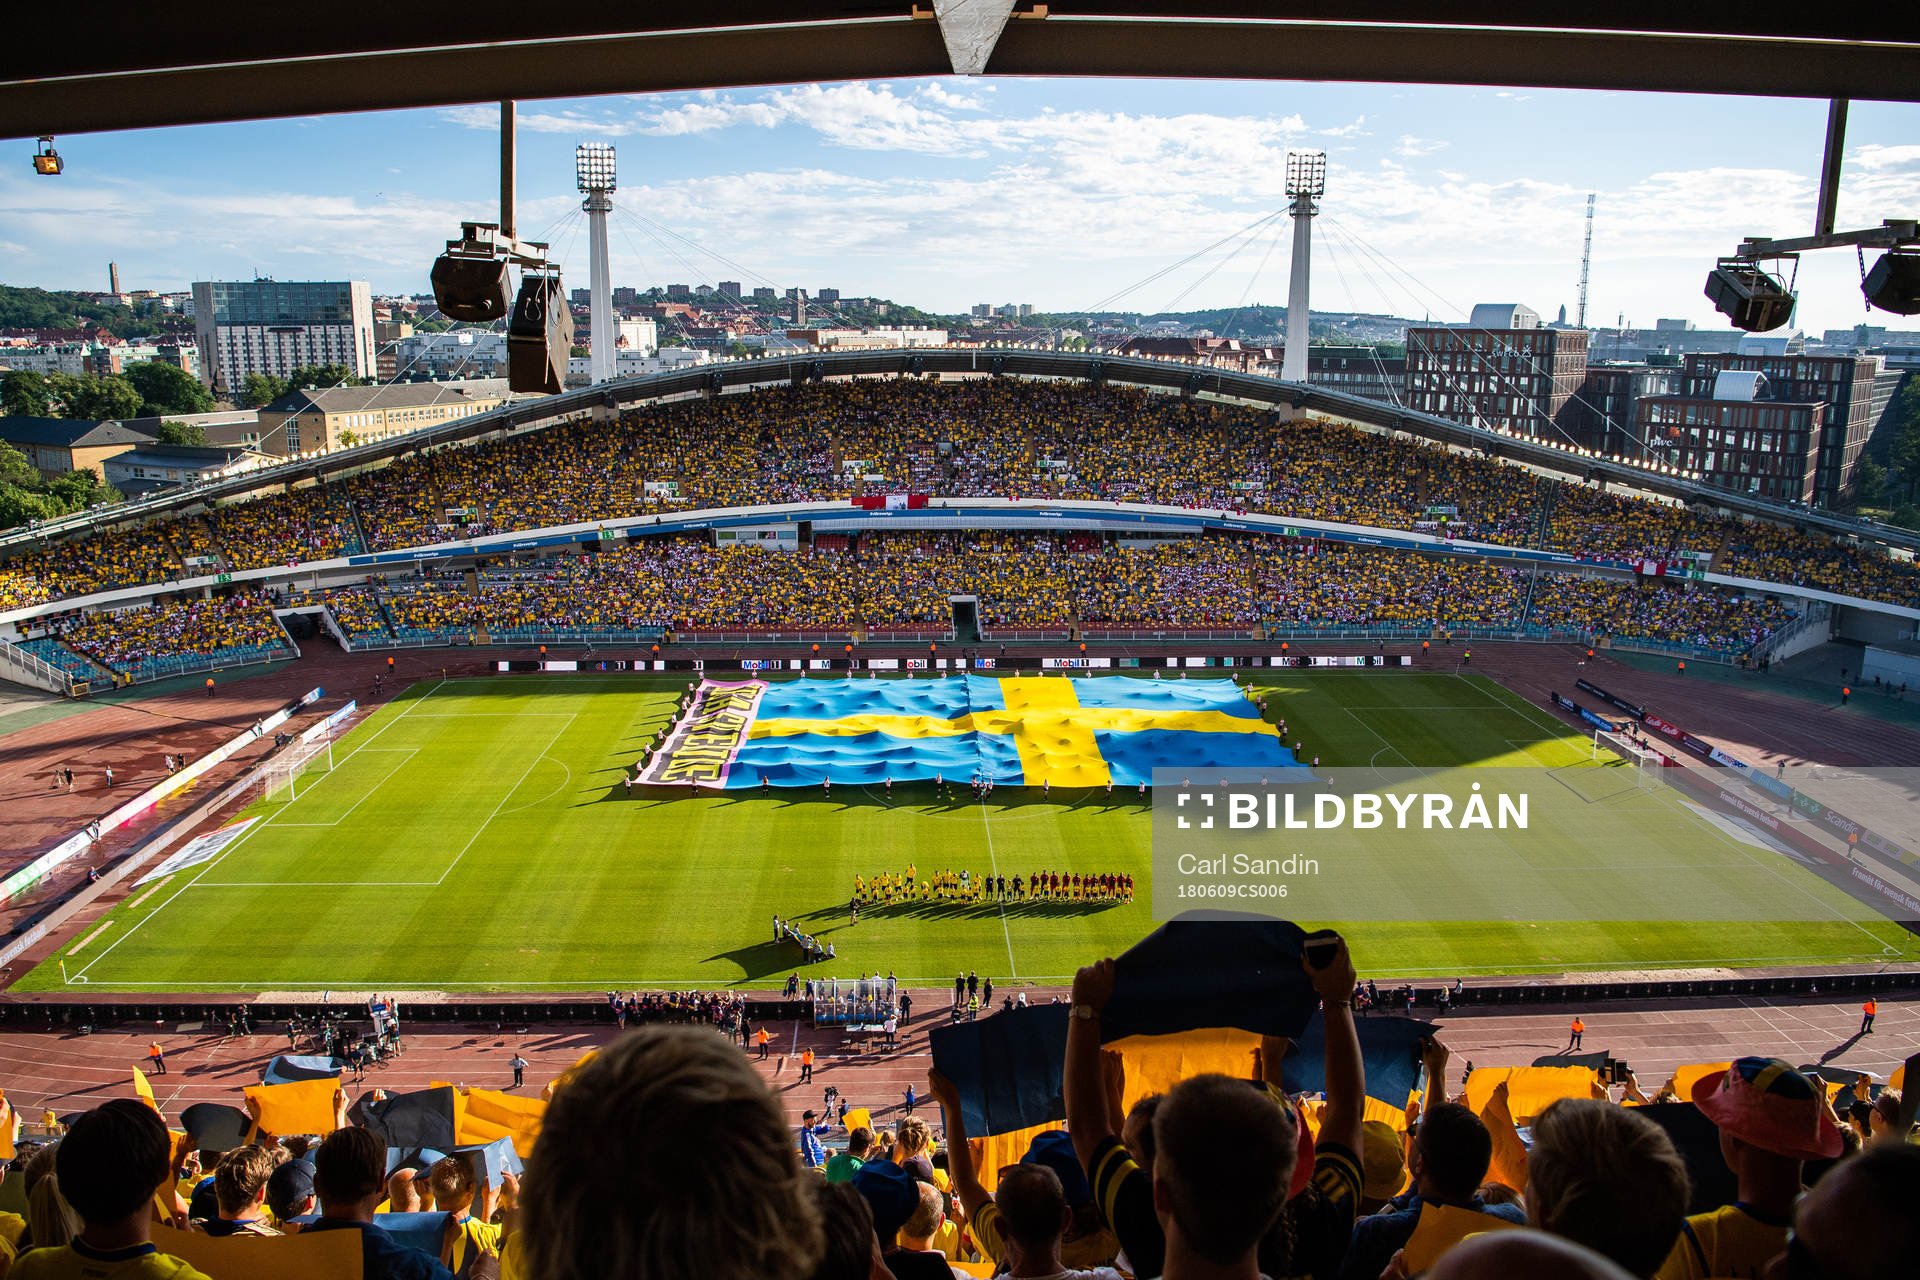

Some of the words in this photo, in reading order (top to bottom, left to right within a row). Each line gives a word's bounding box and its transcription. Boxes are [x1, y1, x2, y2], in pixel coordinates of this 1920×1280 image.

[1650, 439, 1673, 448] pwc
[743, 660, 770, 669] Mobil
[1054, 658, 1080, 668] Mobil
[1825, 811, 1858, 835] Scandic
[1852, 867, 1875, 886] Framåt
[1873, 879, 1885, 892] för
[1884, 886, 1906, 904] svensk
